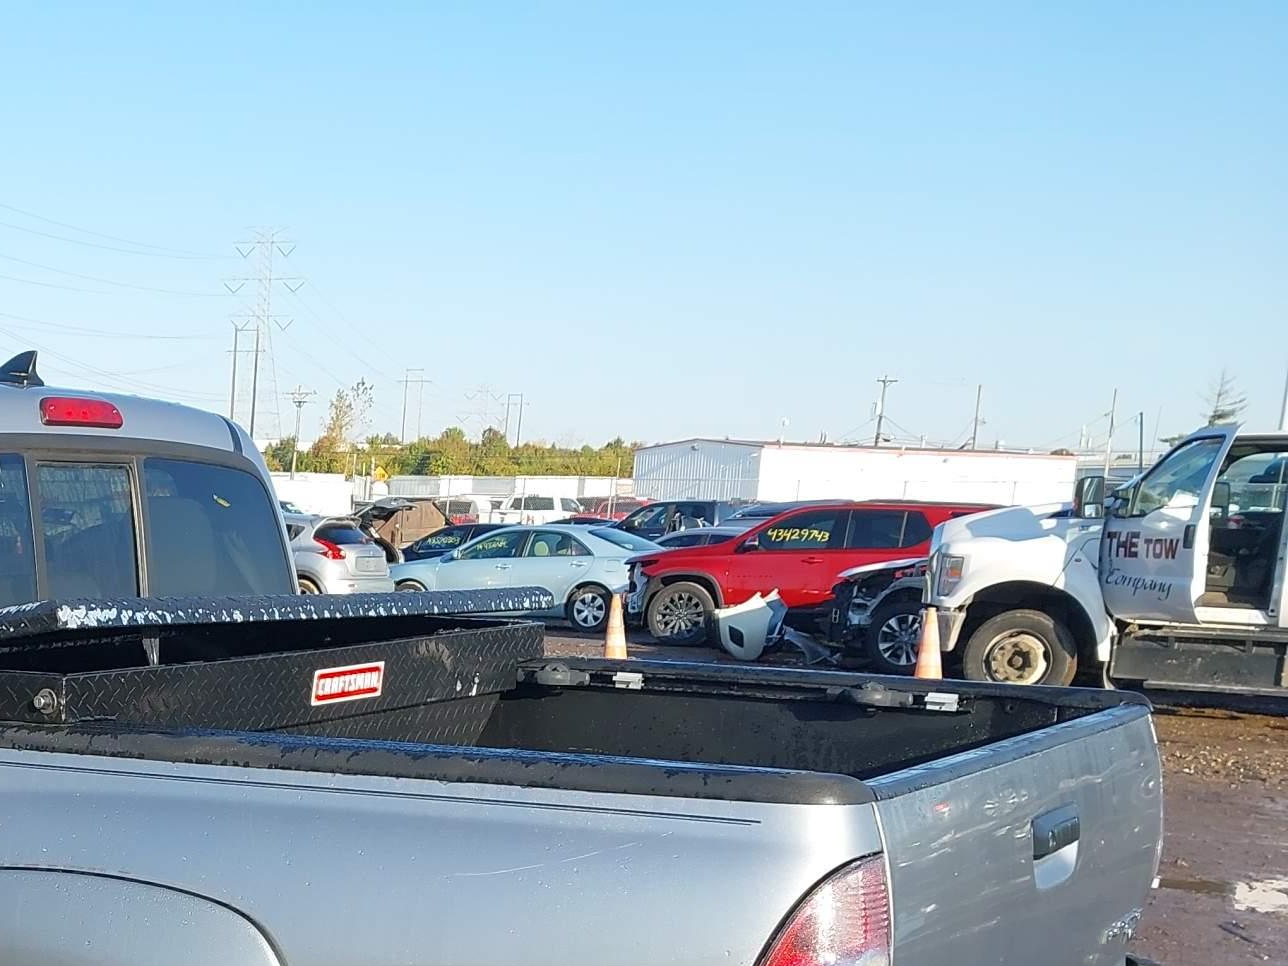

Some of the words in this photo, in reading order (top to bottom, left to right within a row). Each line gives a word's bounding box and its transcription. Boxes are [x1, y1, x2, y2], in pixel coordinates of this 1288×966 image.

[1107, 531, 1141, 558] THE
[1144, 538, 1180, 560] TOW
[1105, 568, 1172, 600] Company
[318, 671, 379, 696] CRAFTSMAN
